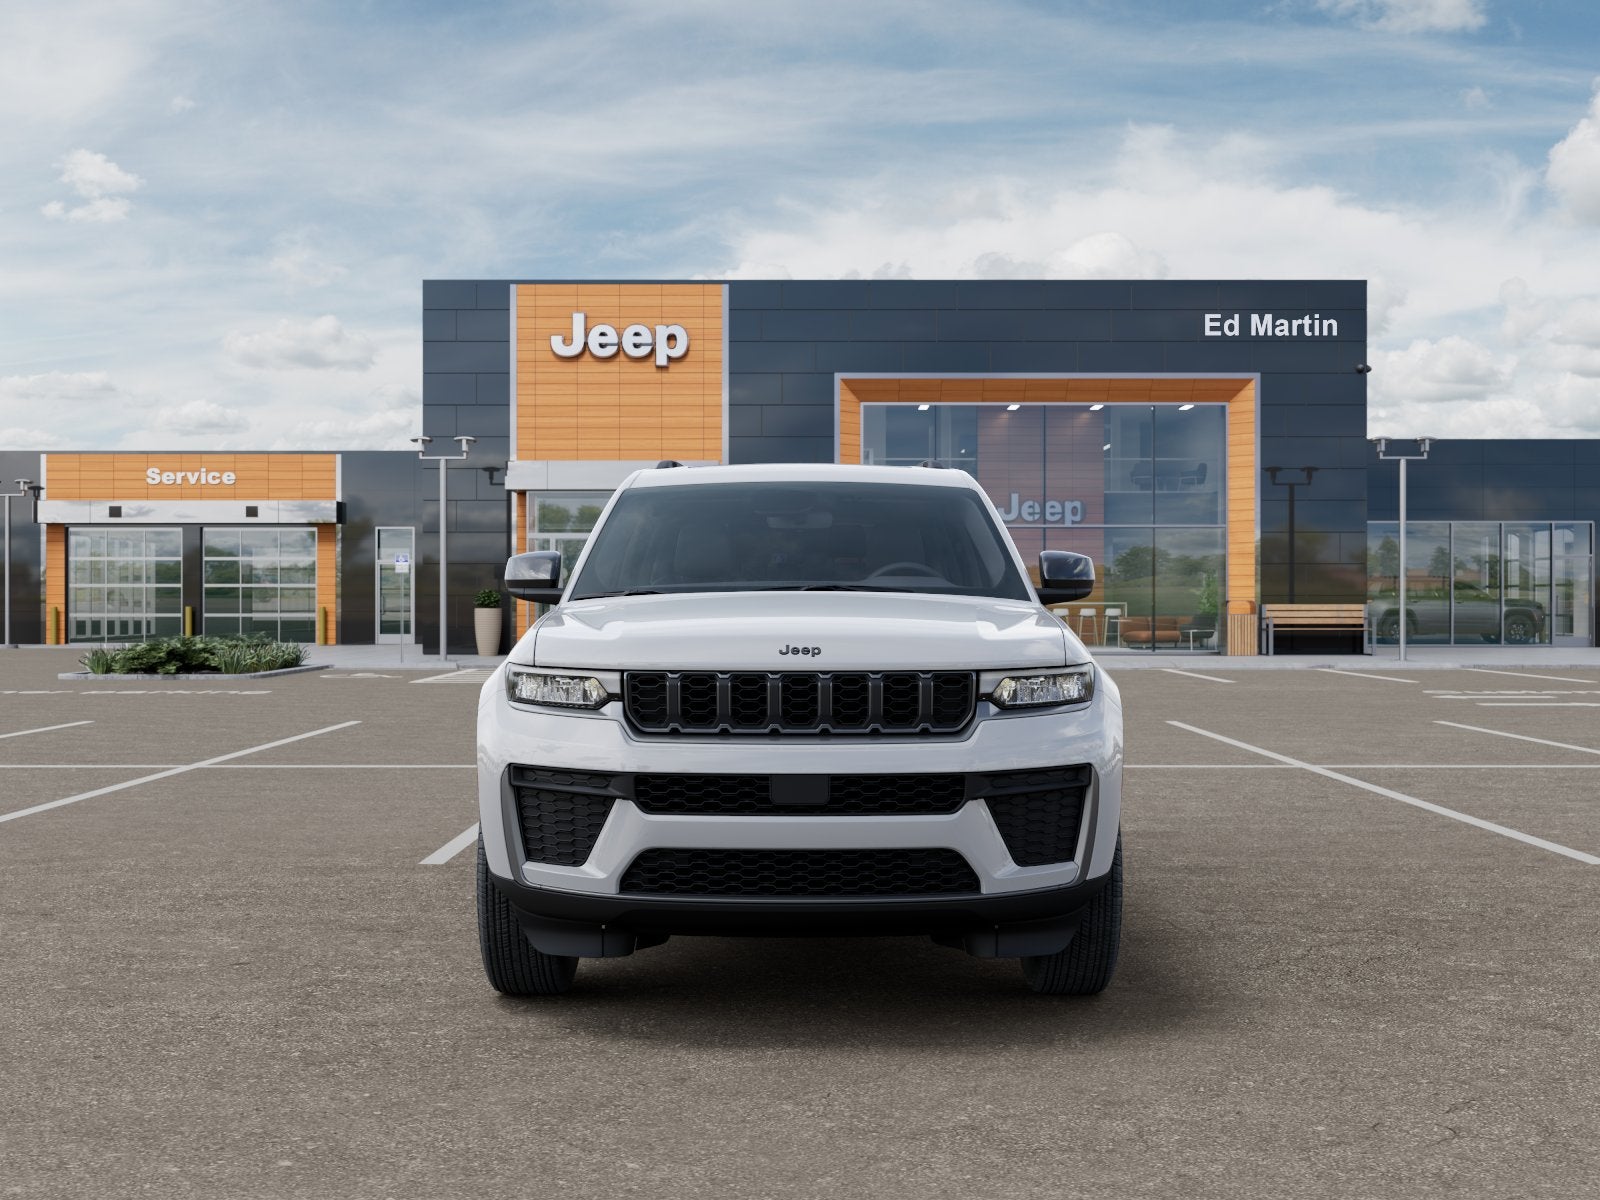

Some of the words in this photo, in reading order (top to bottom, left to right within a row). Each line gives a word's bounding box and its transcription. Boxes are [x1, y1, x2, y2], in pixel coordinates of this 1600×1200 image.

[1204, 313, 1239, 336] Ed
[1250, 313, 1338, 336] Martin
[550, 312, 688, 367] Jeep
[146, 467, 236, 485] Service
[998, 493, 1082, 526] Jeep
[779, 644, 822, 657] Jeep
